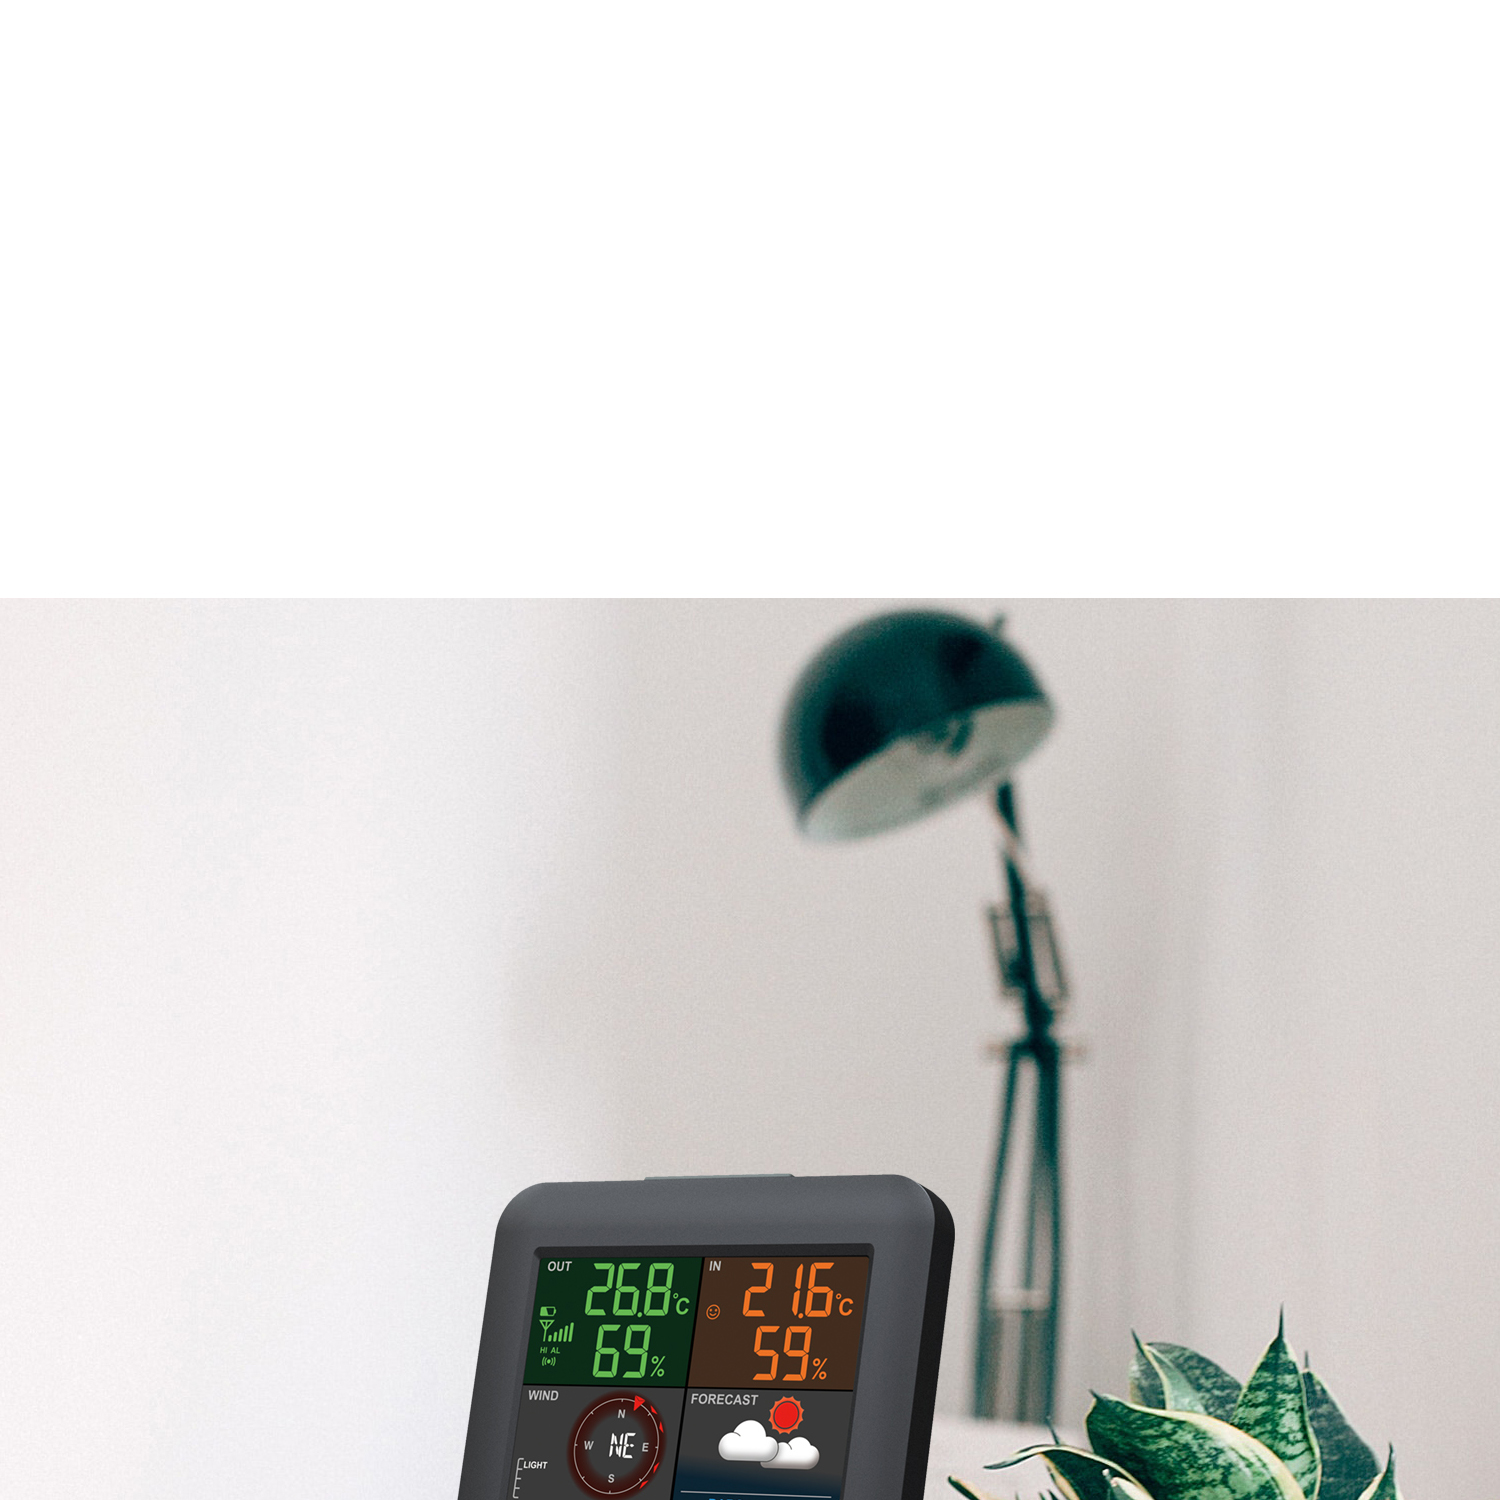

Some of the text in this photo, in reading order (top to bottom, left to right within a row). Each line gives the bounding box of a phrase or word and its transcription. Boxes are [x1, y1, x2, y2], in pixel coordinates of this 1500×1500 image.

[547, 1261, 573, 1272] OUT
[709, 1260, 722, 1272] IN
[528, 1390, 559, 1401] WIND
[690, 1393, 759, 1406] FORECAST
[617, 1409, 626, 1419] N
[584, 1440, 594, 1450] W
[608, 1432, 636, 1459] NE
[642, 1442, 649, 1452] E
[523, 1461, 548, 1470] LIGHT
[607, 1474, 615, 1483] S
